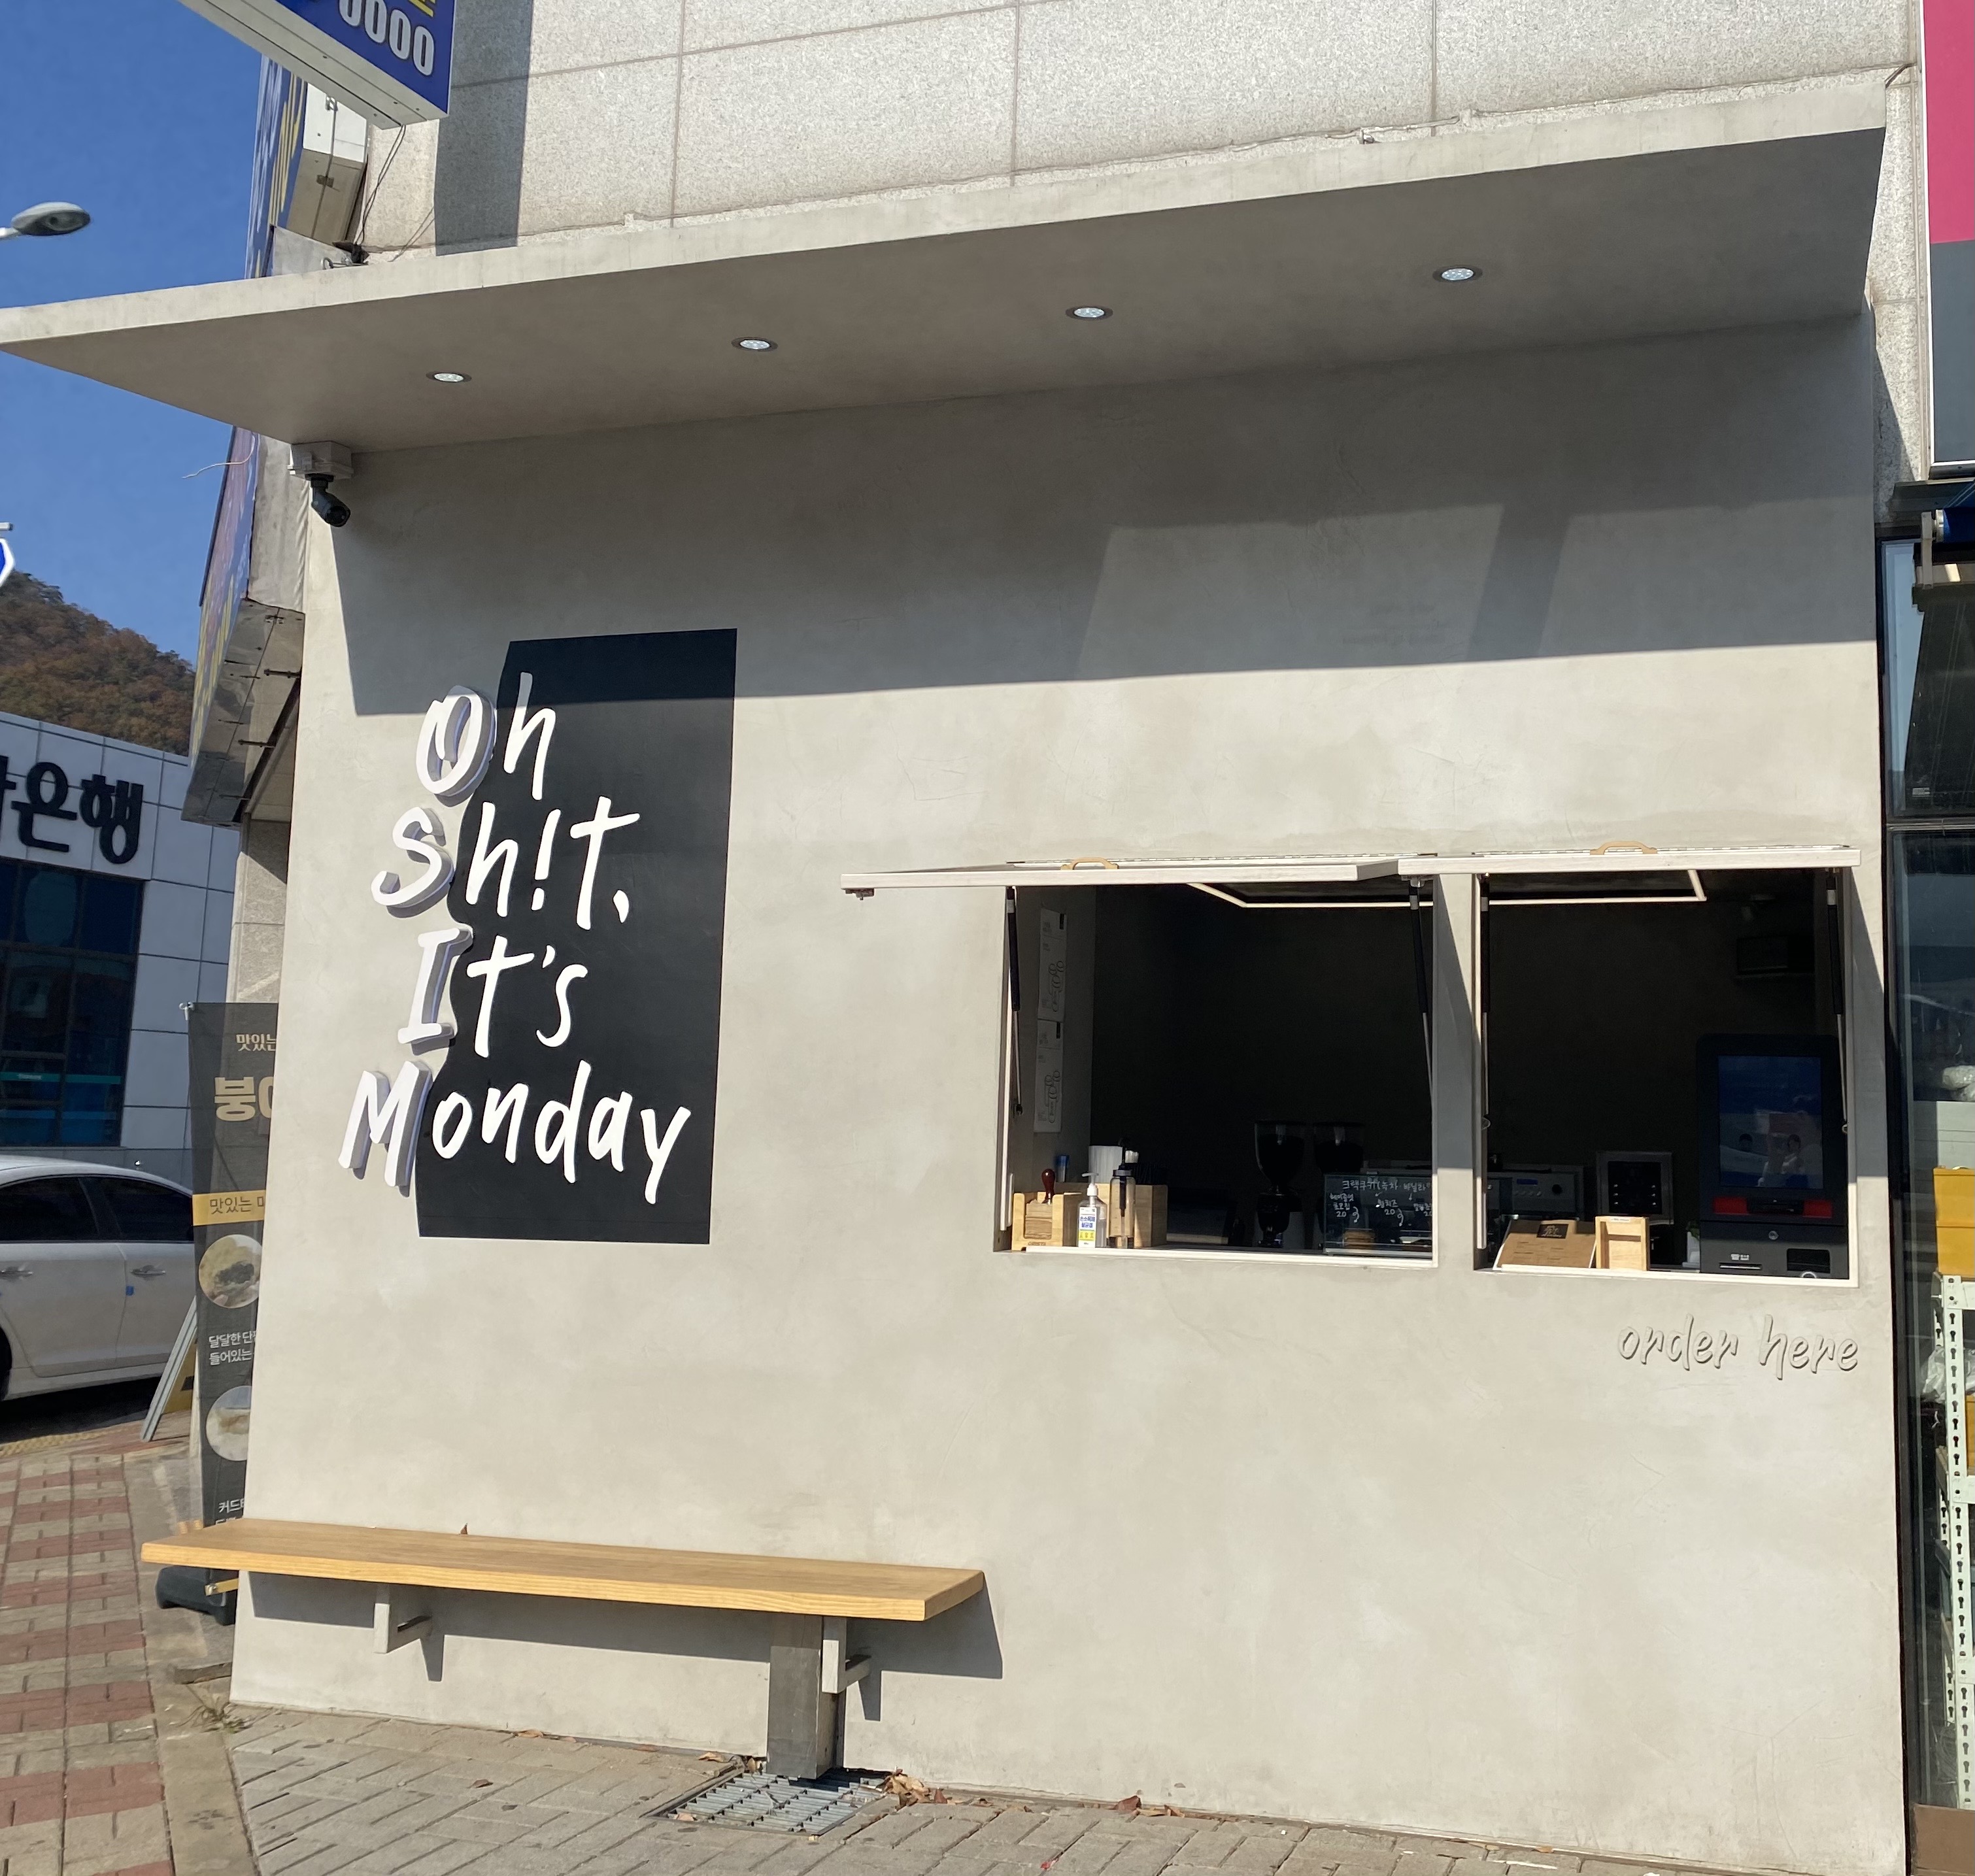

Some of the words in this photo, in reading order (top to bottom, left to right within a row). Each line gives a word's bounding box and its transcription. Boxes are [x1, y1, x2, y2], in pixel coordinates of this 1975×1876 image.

[415, 671, 557, 801] Oh
[371, 796, 640, 930] Sh!t,
[397, 926, 588, 1058] It's
[235, 1033, 277, 1052] 맛있는
[337, 1060, 691, 1205] Monday
[209, 1196, 252, 1214] 맛있는
[209, 1332, 241, 1348] 달달한
[209, 1348, 252, 1365] 들어있는
[1618, 1313, 1739, 1371] order
[1759, 1314, 1859, 1381] here
